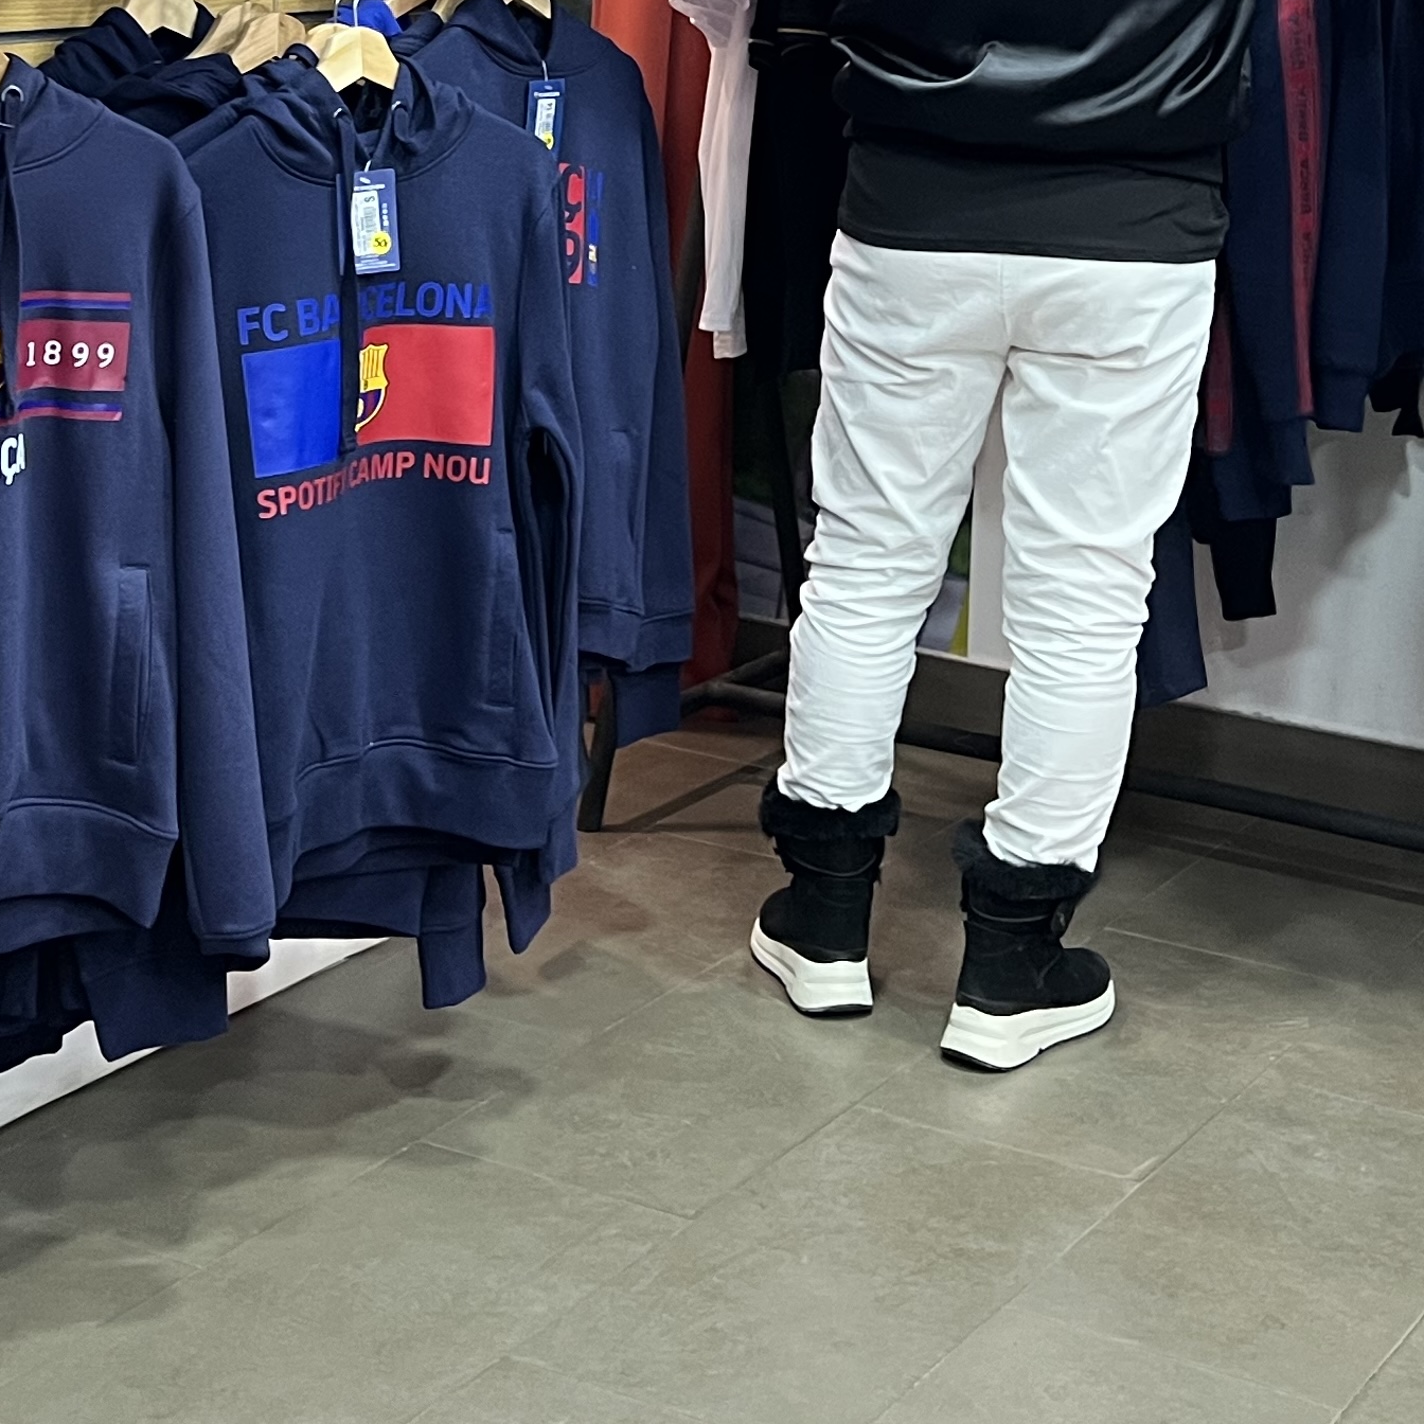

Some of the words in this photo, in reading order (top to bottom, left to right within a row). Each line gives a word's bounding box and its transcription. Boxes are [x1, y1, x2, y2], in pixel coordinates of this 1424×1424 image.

[237, 303, 289, 345] FC
[296, 281, 494, 337] BACELONA
[26, 339, 115, 369] 1899
[350, 451, 415, 488] CAMP
[423, 452, 491, 486] NOU
